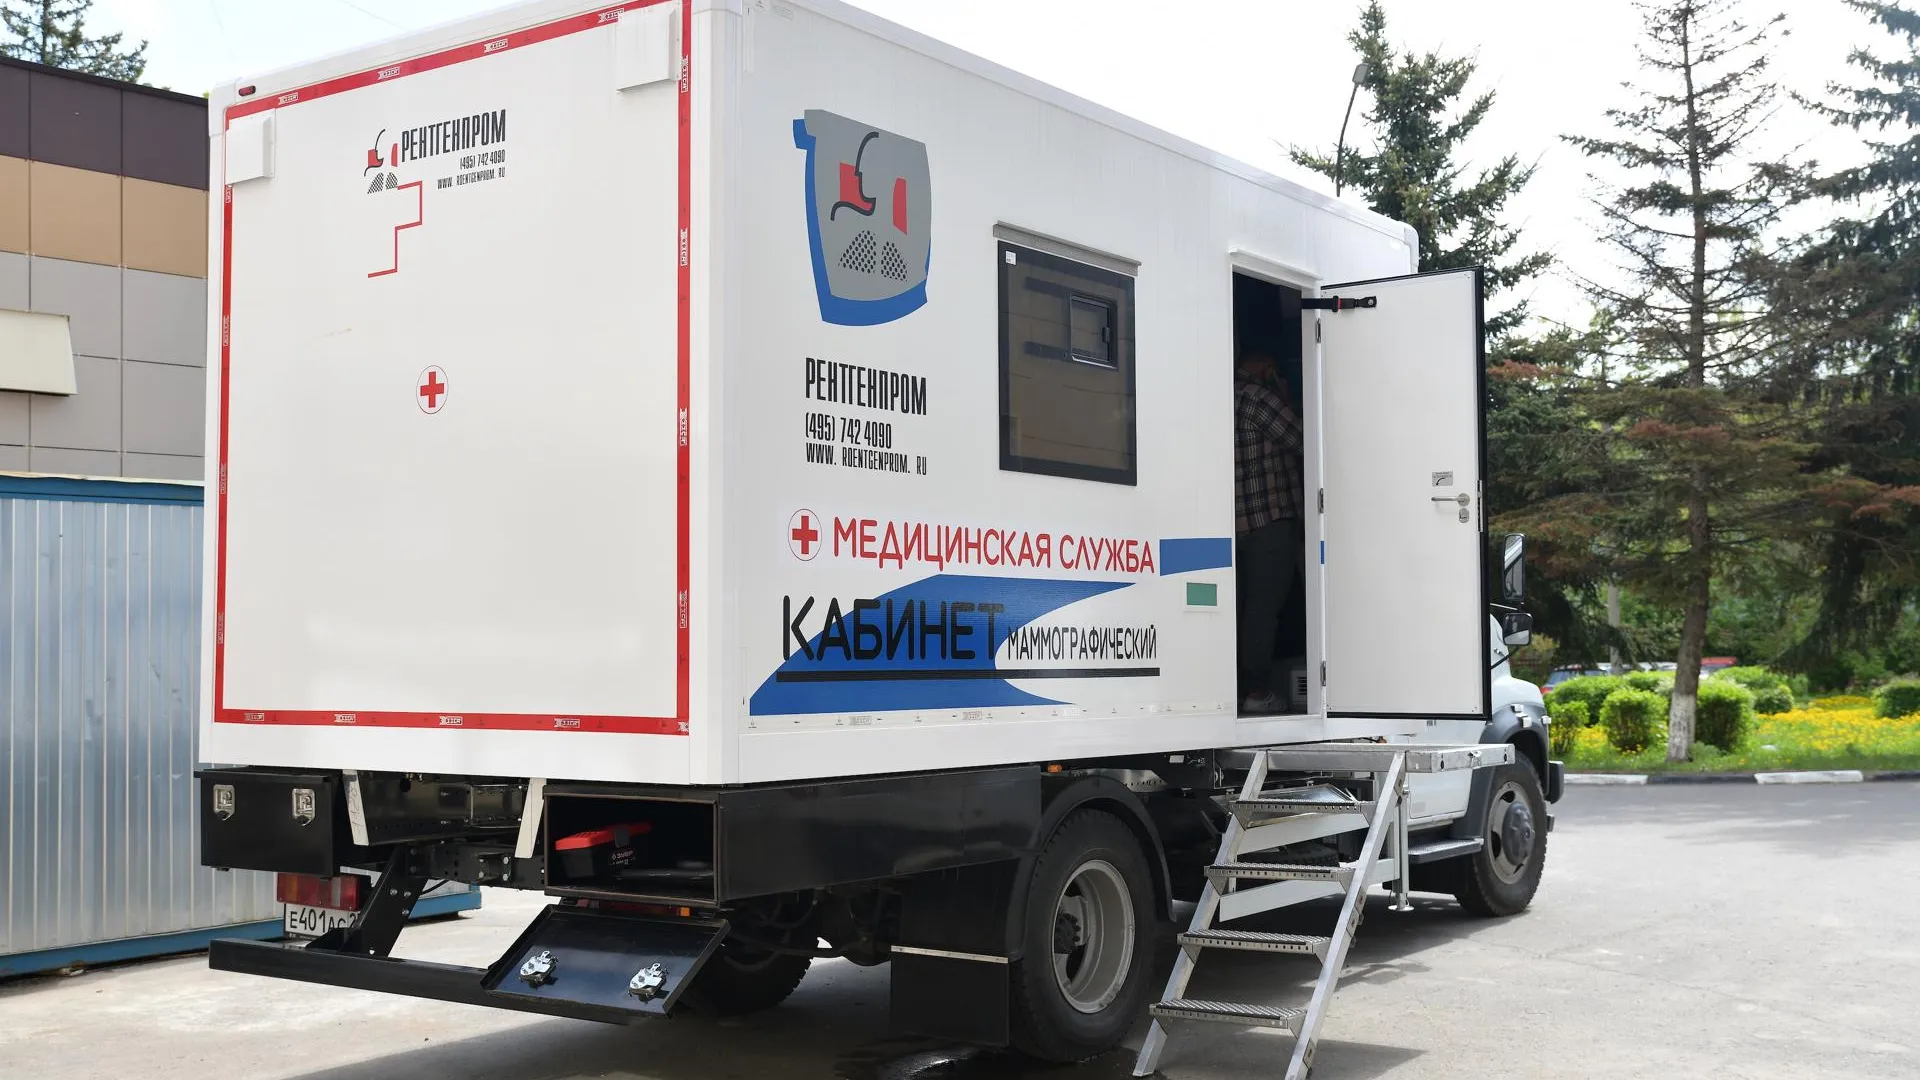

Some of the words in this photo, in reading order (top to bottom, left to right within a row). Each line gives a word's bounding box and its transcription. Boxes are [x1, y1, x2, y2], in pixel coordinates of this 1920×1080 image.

[402, 109, 506, 162] РЕНТГЕНПРОМ
[460, 155, 476, 170] (495)
[477, 152, 489, 167] 742
[490, 149, 506, 164] 4090
[498, 167, 506, 178] RU
[806, 357, 927, 415] РЕНТГЕНПРОМ
[806, 412, 835, 441] (495)
[840, 417, 861, 445] 742
[864, 421, 892, 449] 4090
[916, 456, 927, 475] RU
[832, 516, 1051, 571] МЕДИЦИНСКАЯ
[1059, 534, 1156, 574] СЛУЖБА
[782, 595, 1005, 661] КАБИНЕТ
[1007, 624, 1157, 661] МАММОГРАФИЧЕСКИЙ
